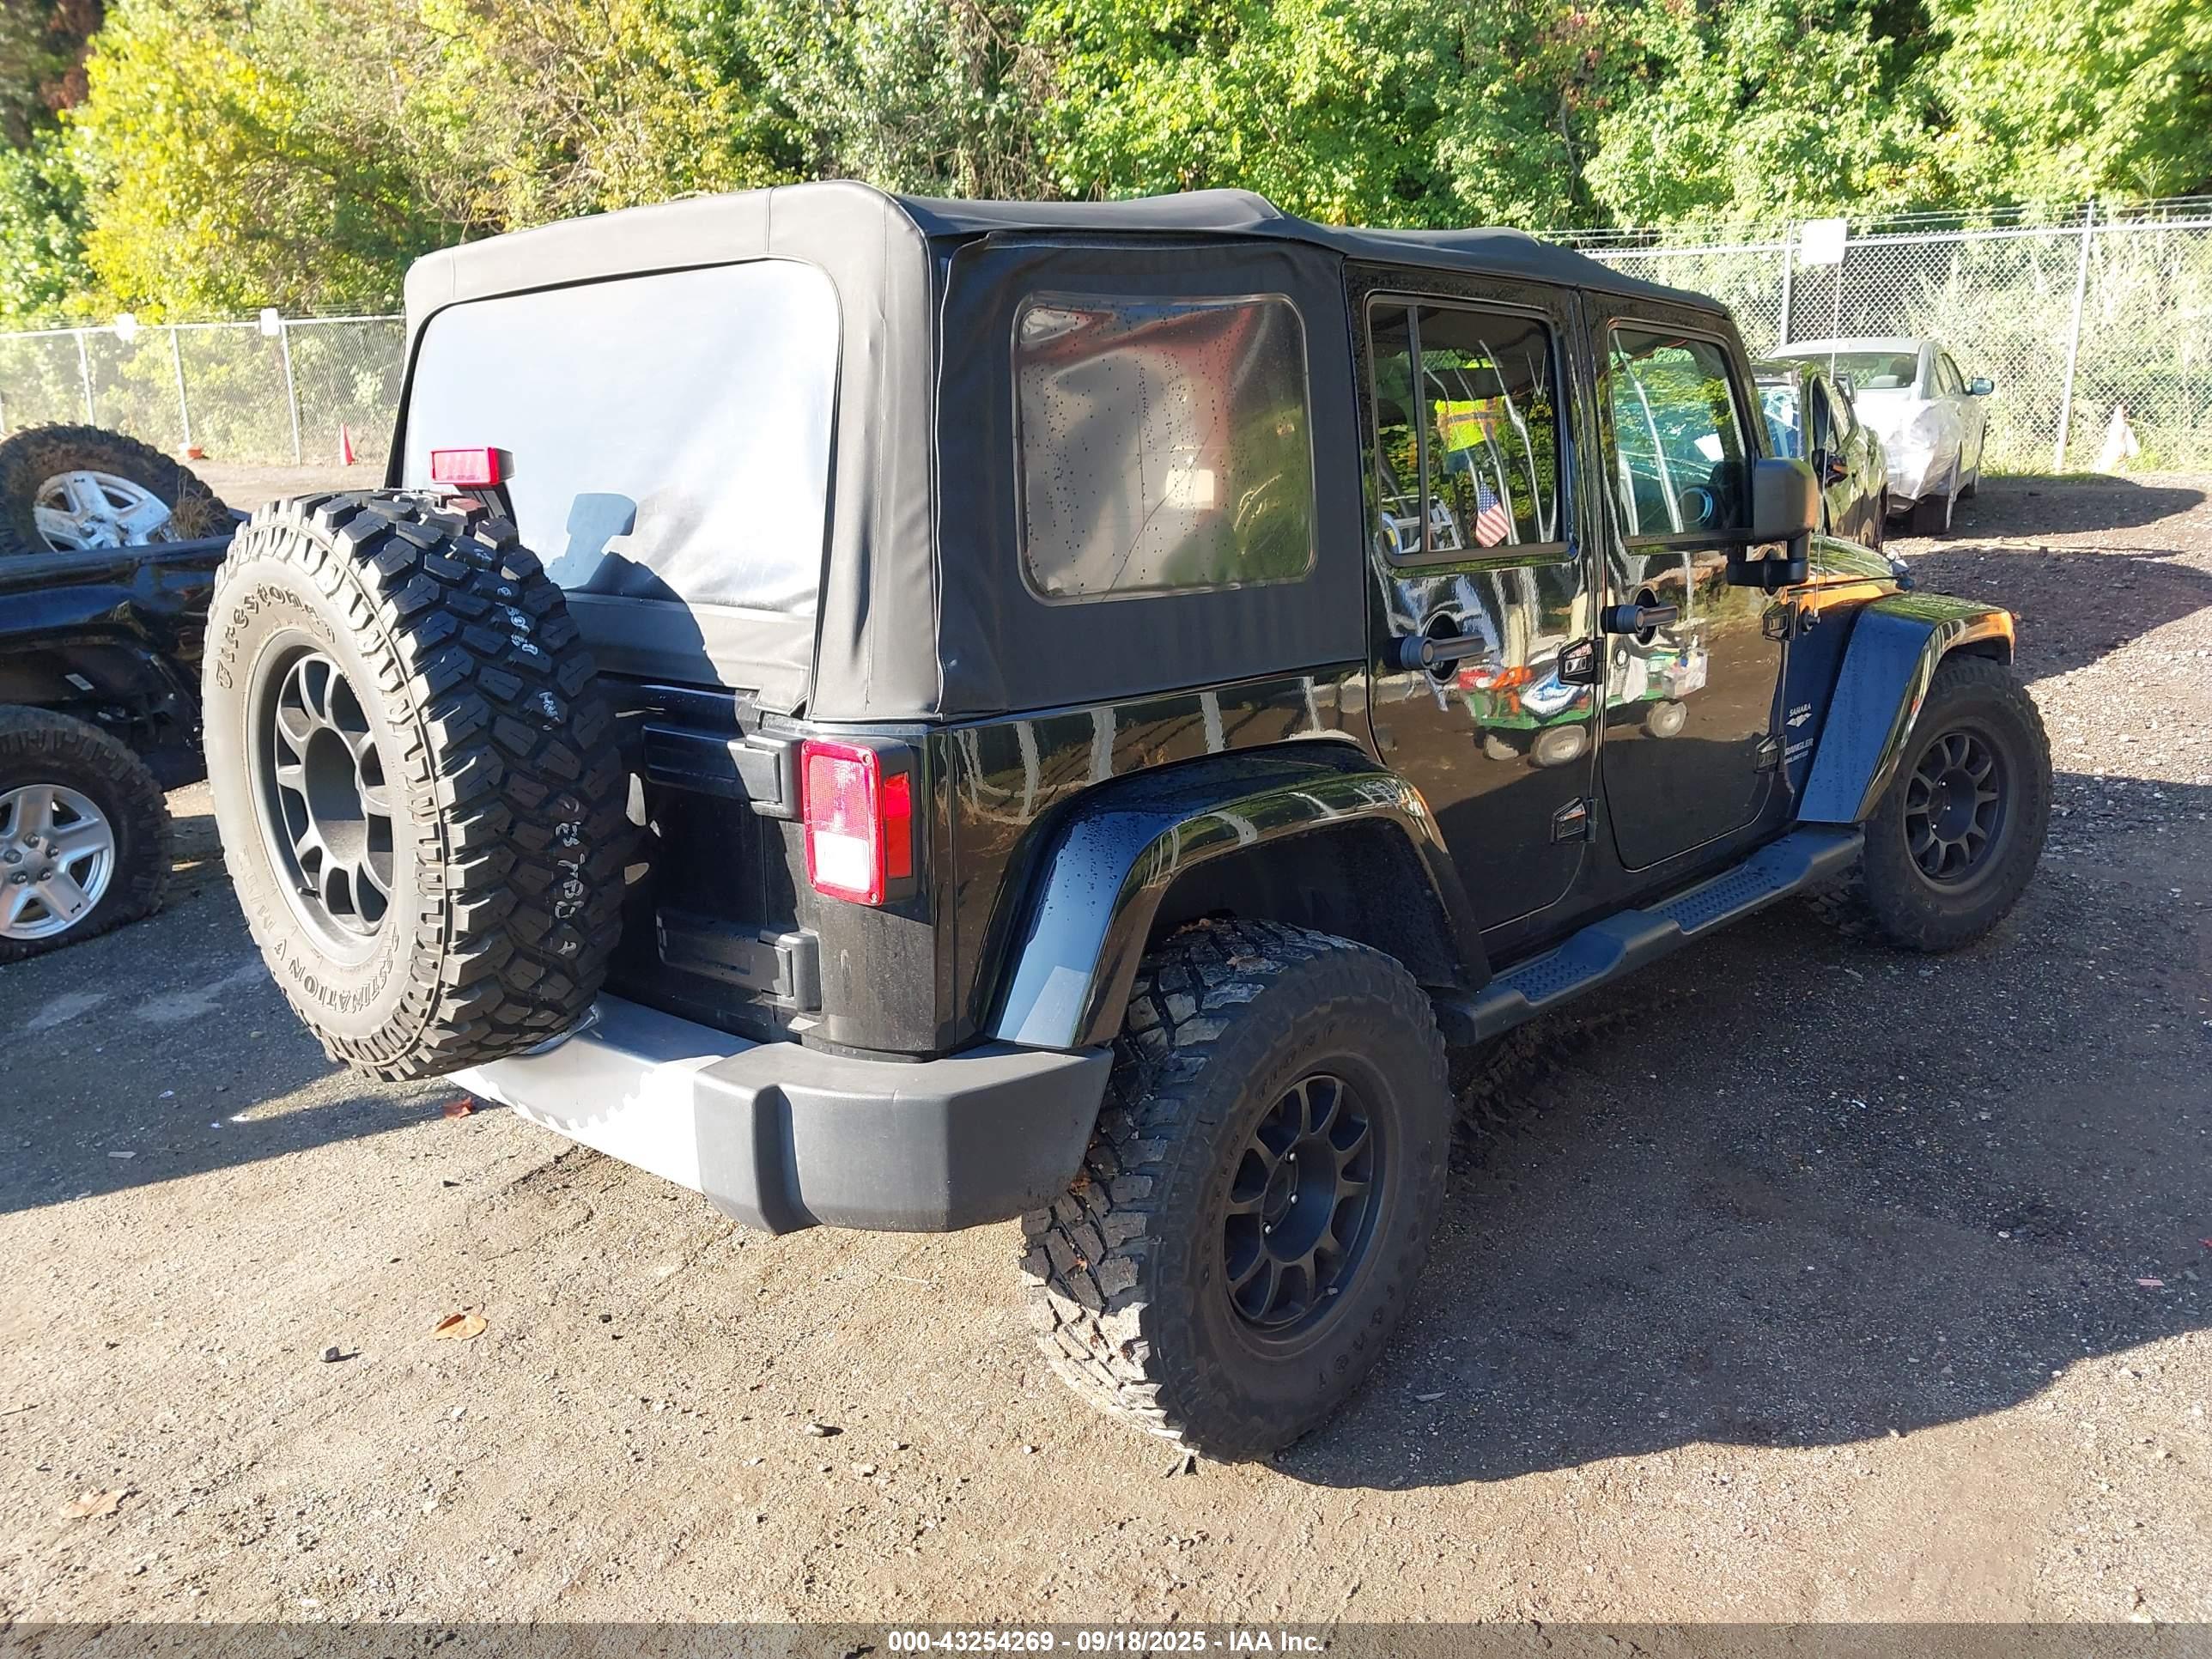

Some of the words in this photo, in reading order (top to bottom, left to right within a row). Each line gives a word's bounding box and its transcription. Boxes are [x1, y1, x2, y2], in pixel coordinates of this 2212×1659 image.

[1789, 702, 1811, 717] SAHARA
[1785, 738, 1814, 757] RANGLER
[289, 922, 400, 1013] DESTINATION
